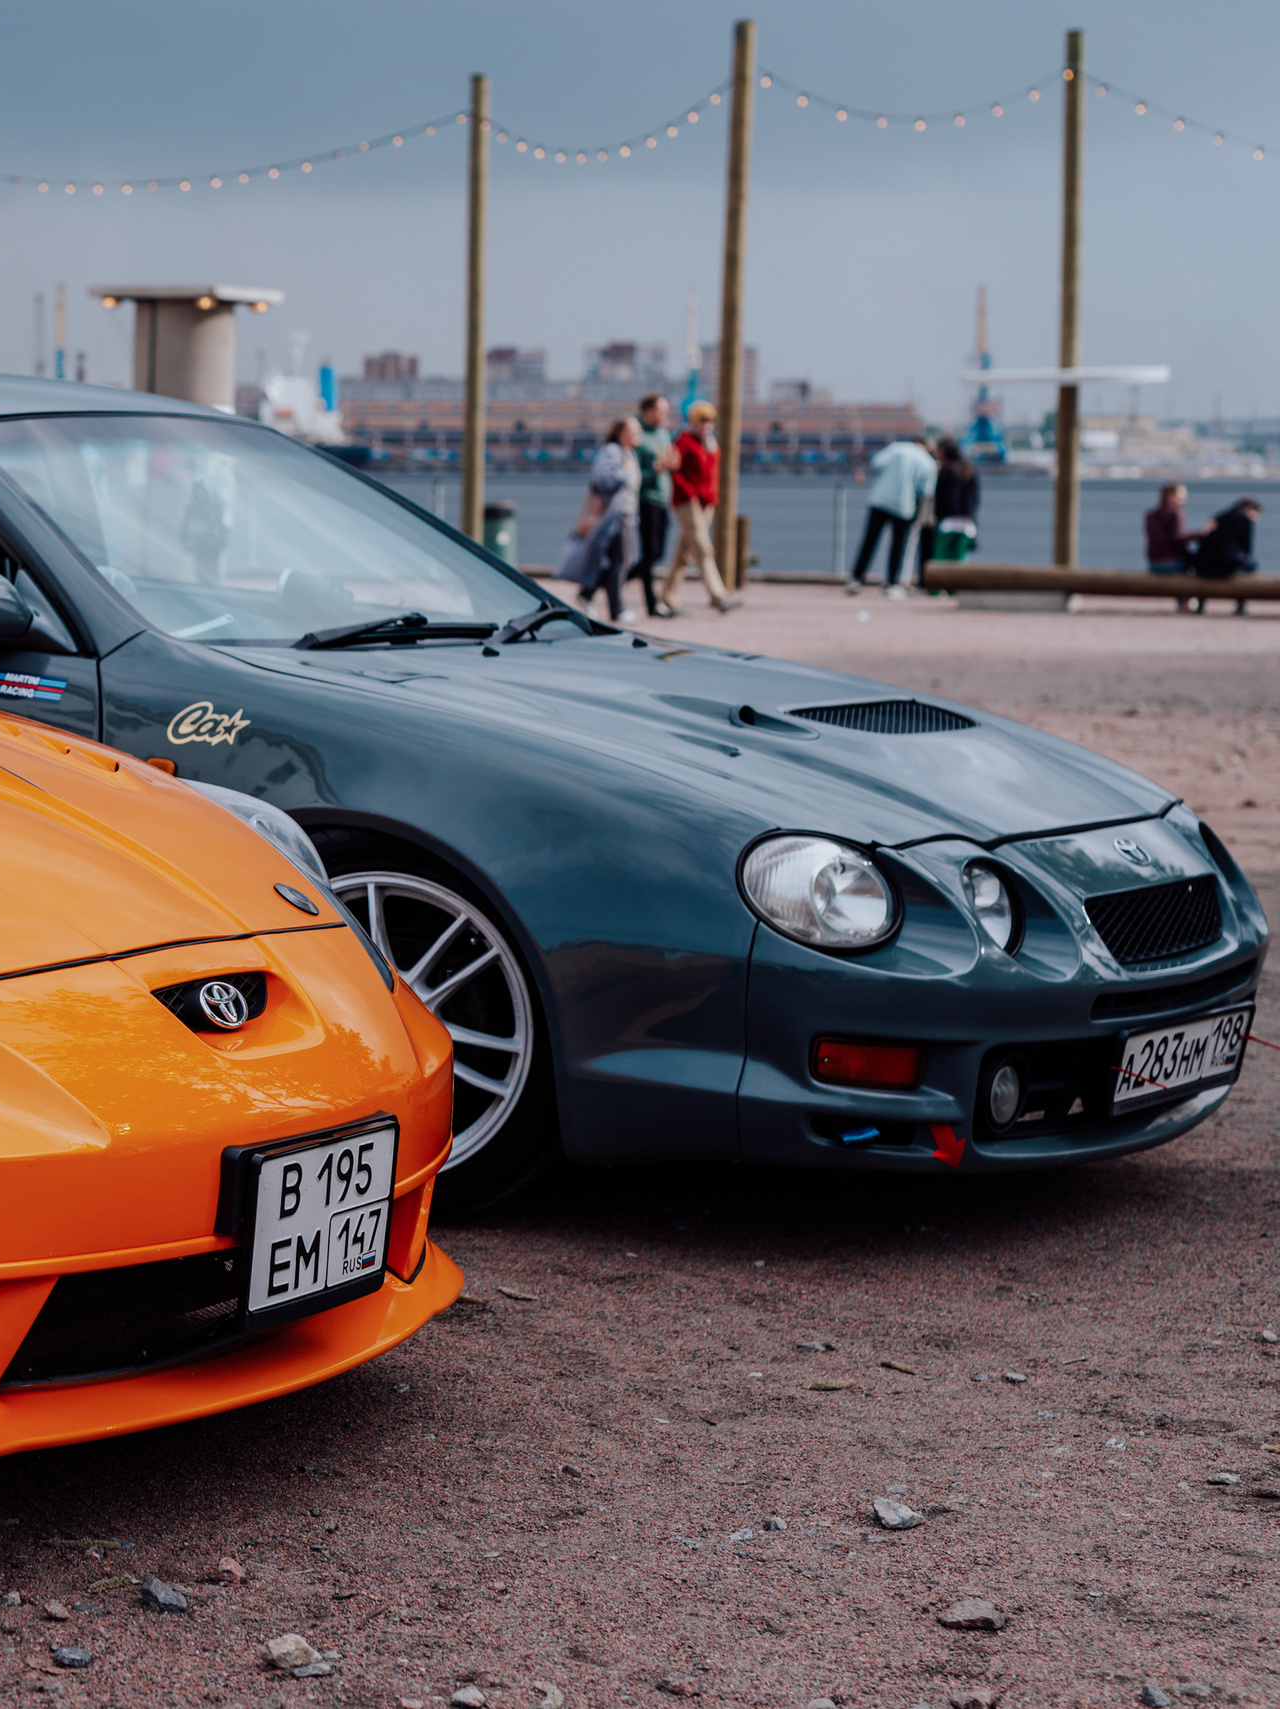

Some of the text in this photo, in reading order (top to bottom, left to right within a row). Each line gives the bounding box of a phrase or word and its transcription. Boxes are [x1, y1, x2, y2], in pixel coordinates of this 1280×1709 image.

[0, 684, 35, 699] RACING
[1212, 1014, 1244, 1054] 198
[1209, 1053, 1227, 1068] RUS
[317, 1142, 375, 1207] 195
[337, 1208, 382, 1259] 147
[342, 1256, 363, 1276] RUS
